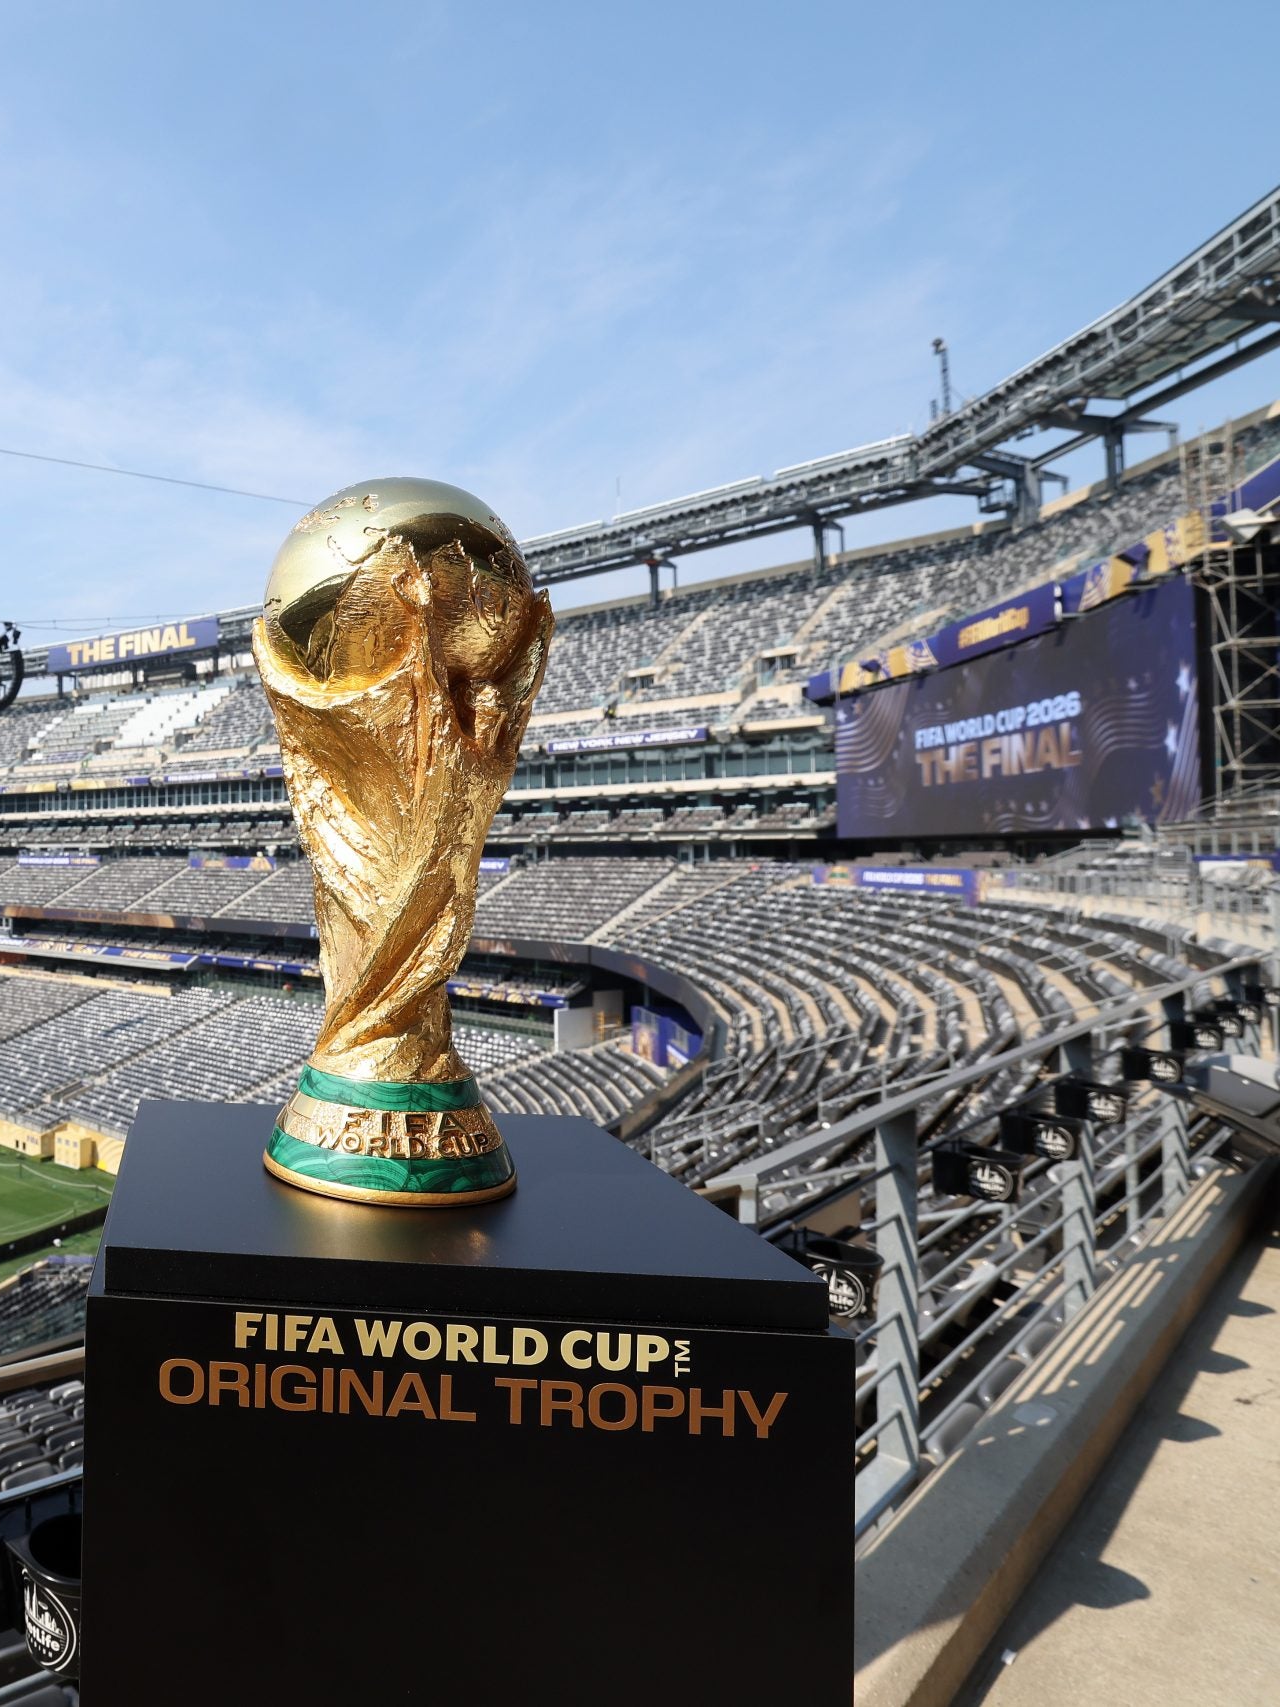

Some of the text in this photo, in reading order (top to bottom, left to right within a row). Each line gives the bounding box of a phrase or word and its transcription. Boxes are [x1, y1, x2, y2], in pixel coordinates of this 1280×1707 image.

[66, 624, 196, 666] THE FINAL
[553, 729, 698, 751] NEW YORK NEW JERSEY
[915, 691, 1082, 750] FIFA WORLD CUP 2026
[915, 722, 1082, 787] THE FINAL
[315, 1124, 489, 1160] WORLD CUP
[345, 1110, 466, 1138] FIFA
[234, 1311, 345, 1354] FIFA
[356, 1319, 549, 1368] WORLD
[560, 1330, 670, 1373] CUP
[158, 1358, 789, 1439] ORIGINAL TROPHY
